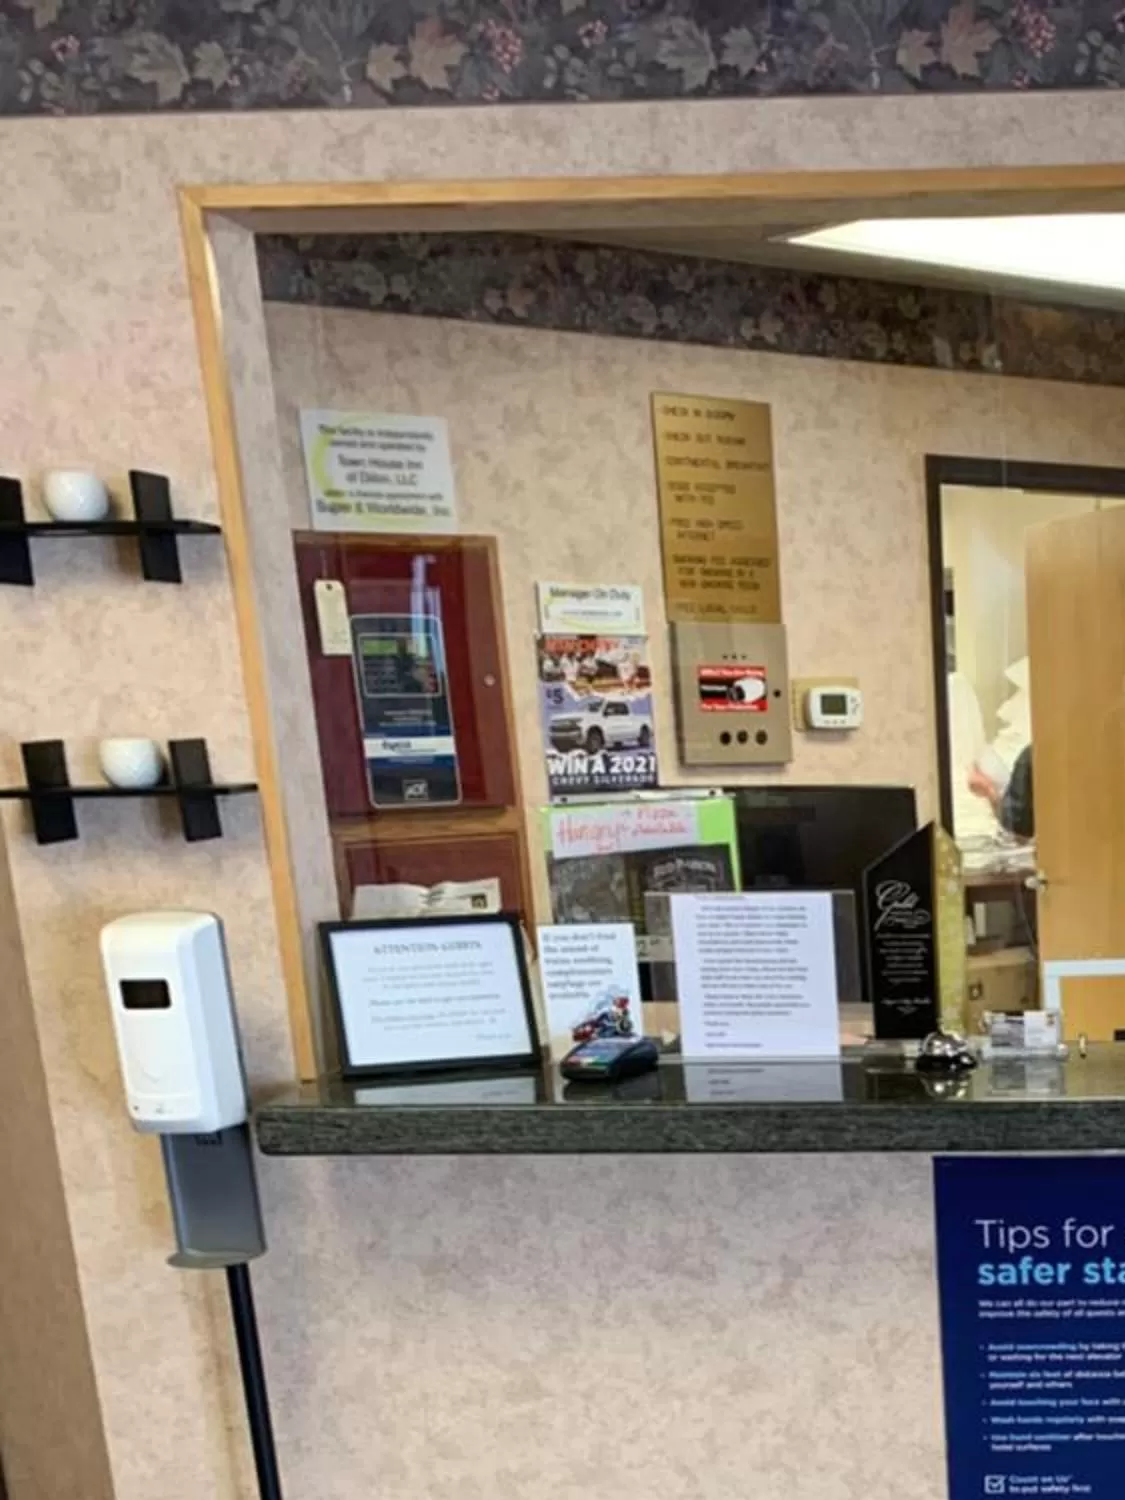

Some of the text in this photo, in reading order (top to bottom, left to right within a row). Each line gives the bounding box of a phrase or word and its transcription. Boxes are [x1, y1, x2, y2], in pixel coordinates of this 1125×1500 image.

[549, 755, 657, 775] WIN A 2021
[975, 1218, 1050, 1253] Tips
[1063, 1217, 1114, 1249] for
[978, 1256, 1071, 1286] safer
